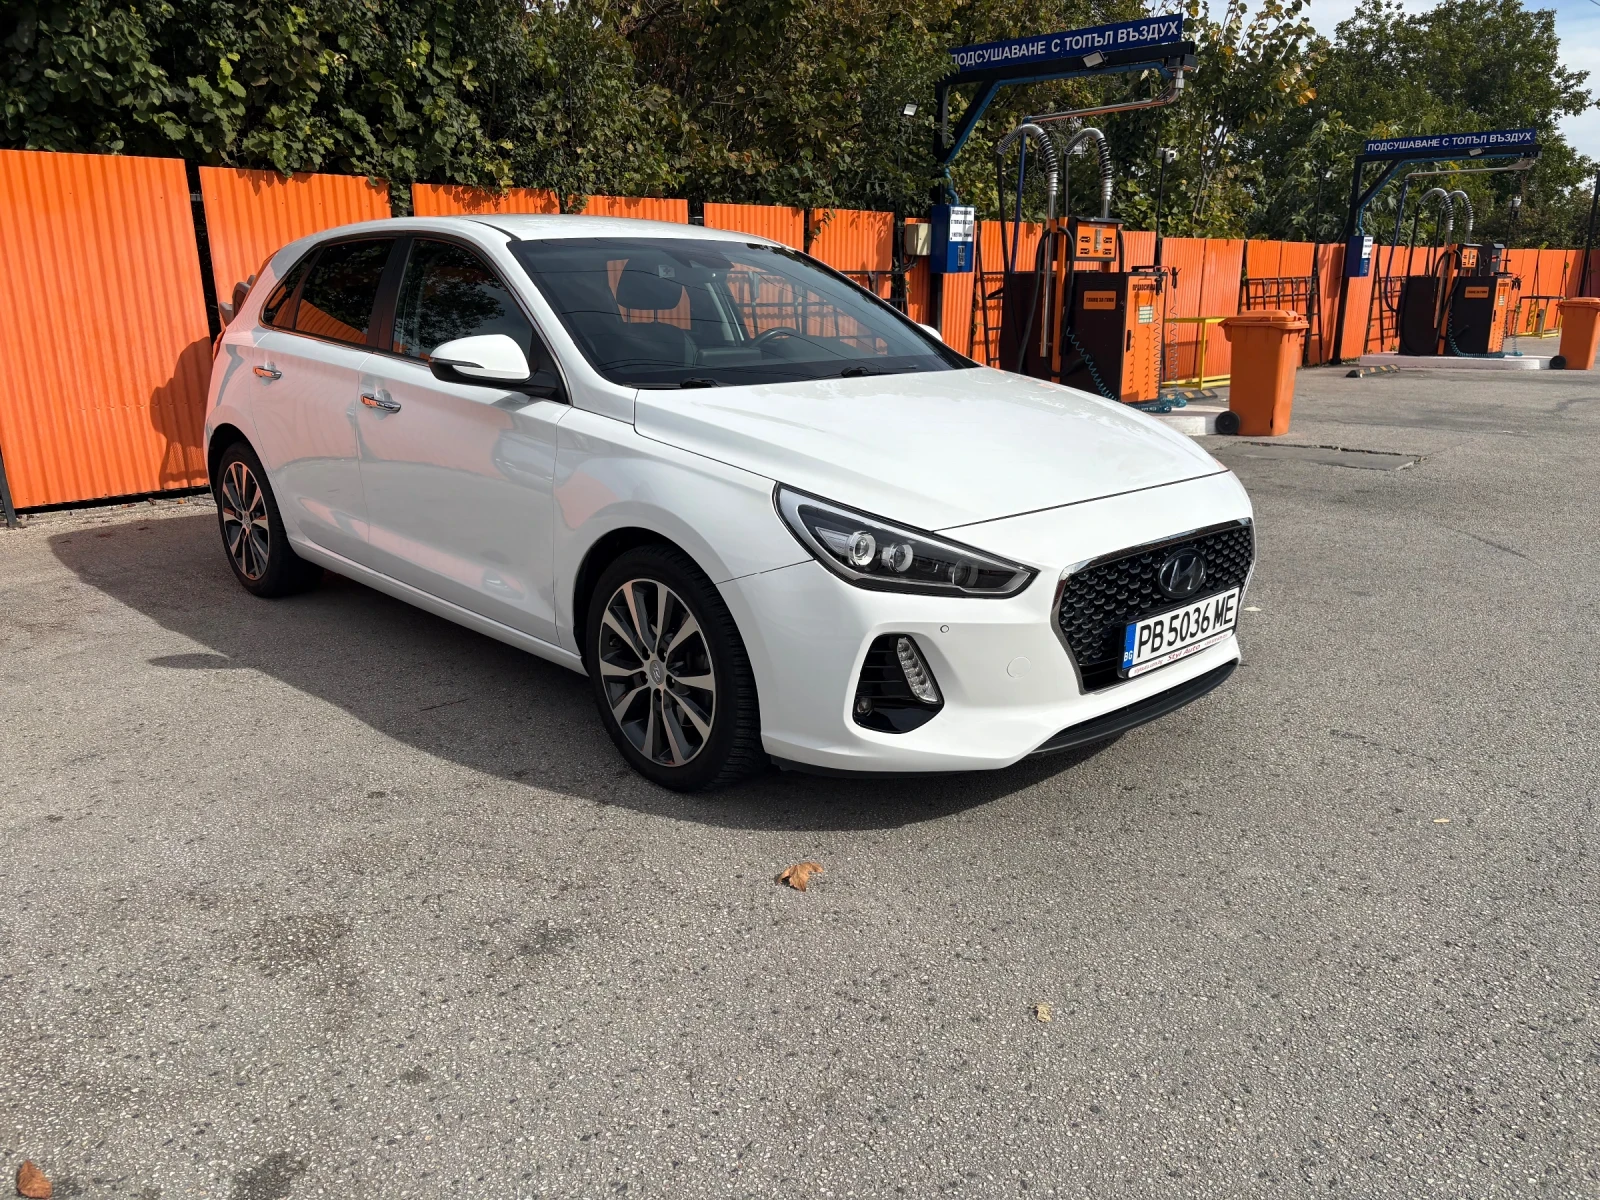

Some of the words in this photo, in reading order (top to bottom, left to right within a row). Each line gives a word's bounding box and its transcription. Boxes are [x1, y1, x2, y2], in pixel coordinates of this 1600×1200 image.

[951, 40, 1046, 67] ПОДСУШАВАНЕ
[1051, 38, 1061, 53] С
[1064, 31, 1114, 51] ТОПЪЛ
[1117, 20, 1179, 43] ВЪЗДУХ
[1367, 138, 1441, 152] ПОДСУШАВАНЕ
[1442, 137, 1449, 146] С
[1452, 135, 1487, 145] ТОПЪЛ
[1490, 131, 1532, 143] ВЪЗДУХ
[1137, 619, 1164, 659] PB
[1167, 602, 1211, 647] 5036
[1212, 593, 1236, 630] ME
[1123, 650, 1134, 662] BG
